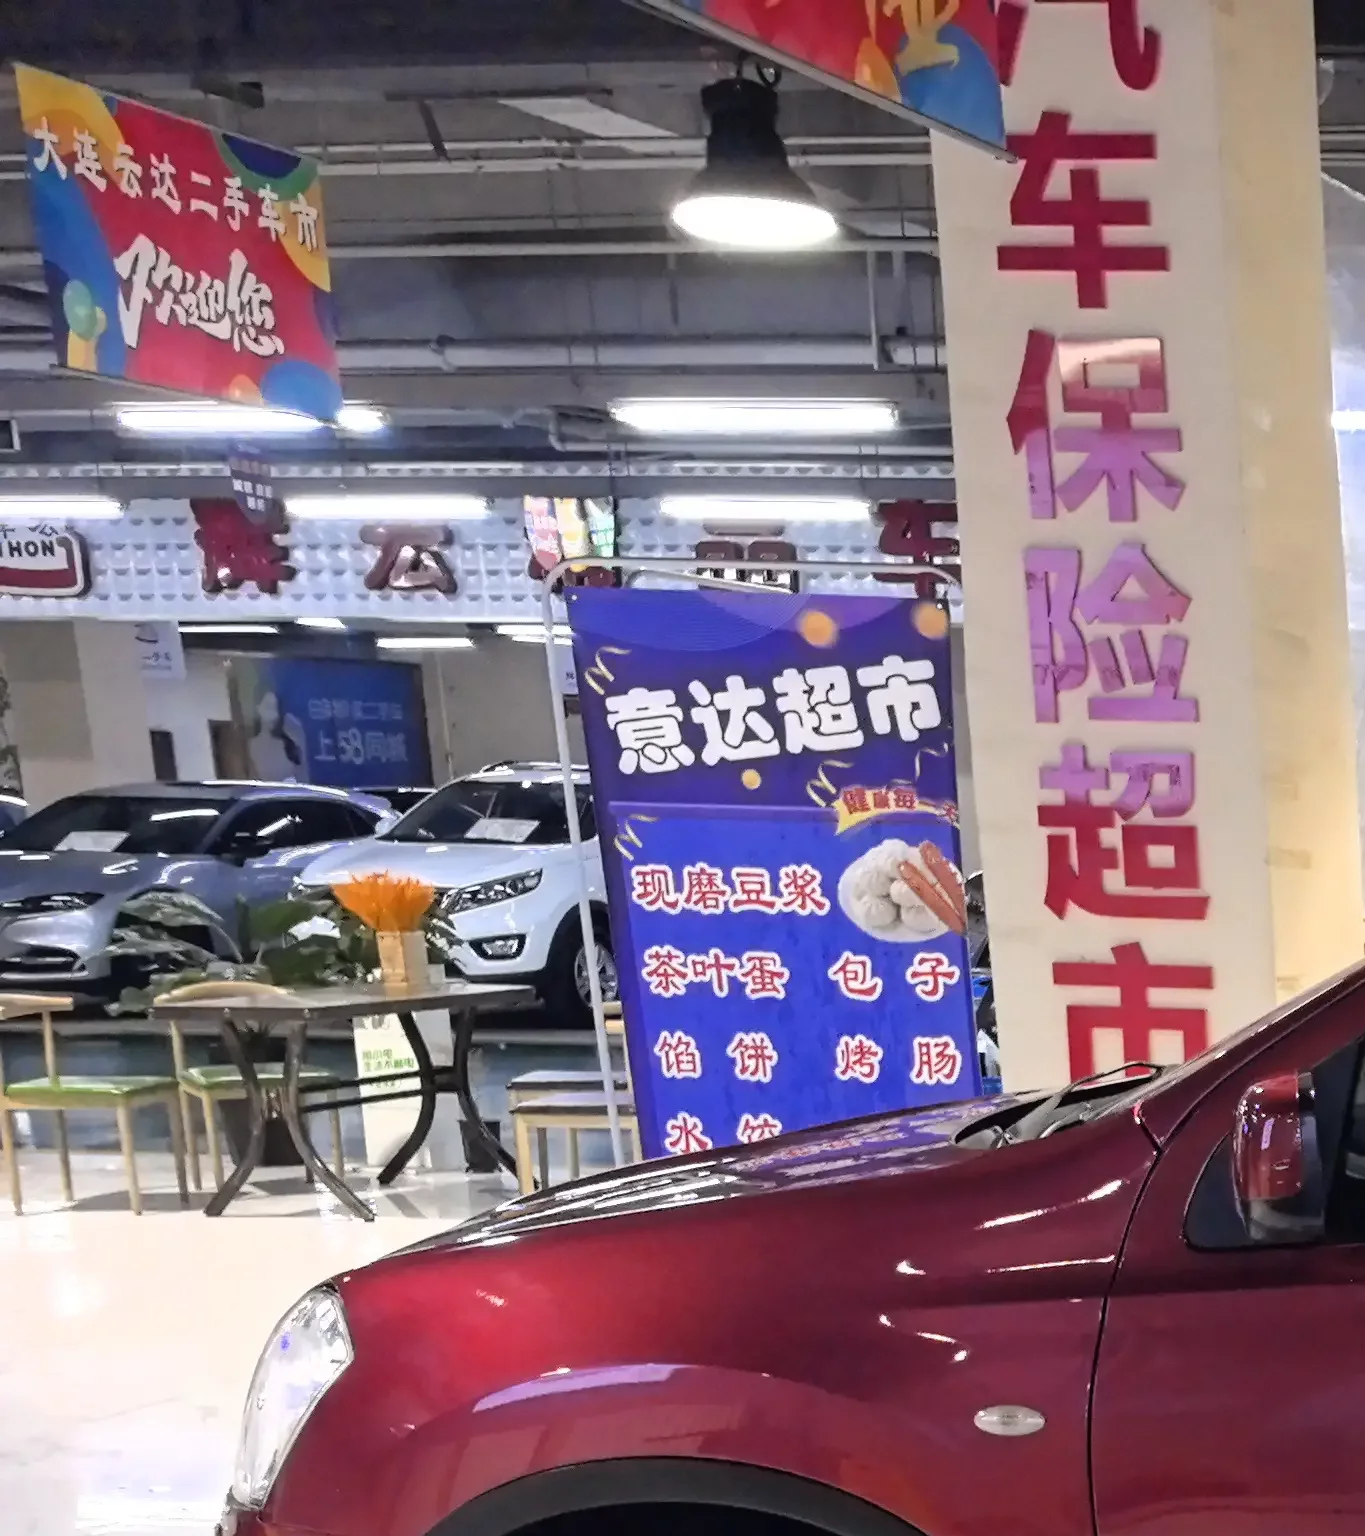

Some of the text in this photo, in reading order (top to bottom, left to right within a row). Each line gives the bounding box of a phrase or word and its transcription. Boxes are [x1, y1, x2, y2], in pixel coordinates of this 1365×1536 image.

[114, 233, 284, 357] 欢迎您
[0, 539, 55, 558] HON
[605, 655, 942, 774] 意达超市
[633, 863, 830, 916] 现磨豆浆
[642, 945, 790, 1000] 茶叶蛋
